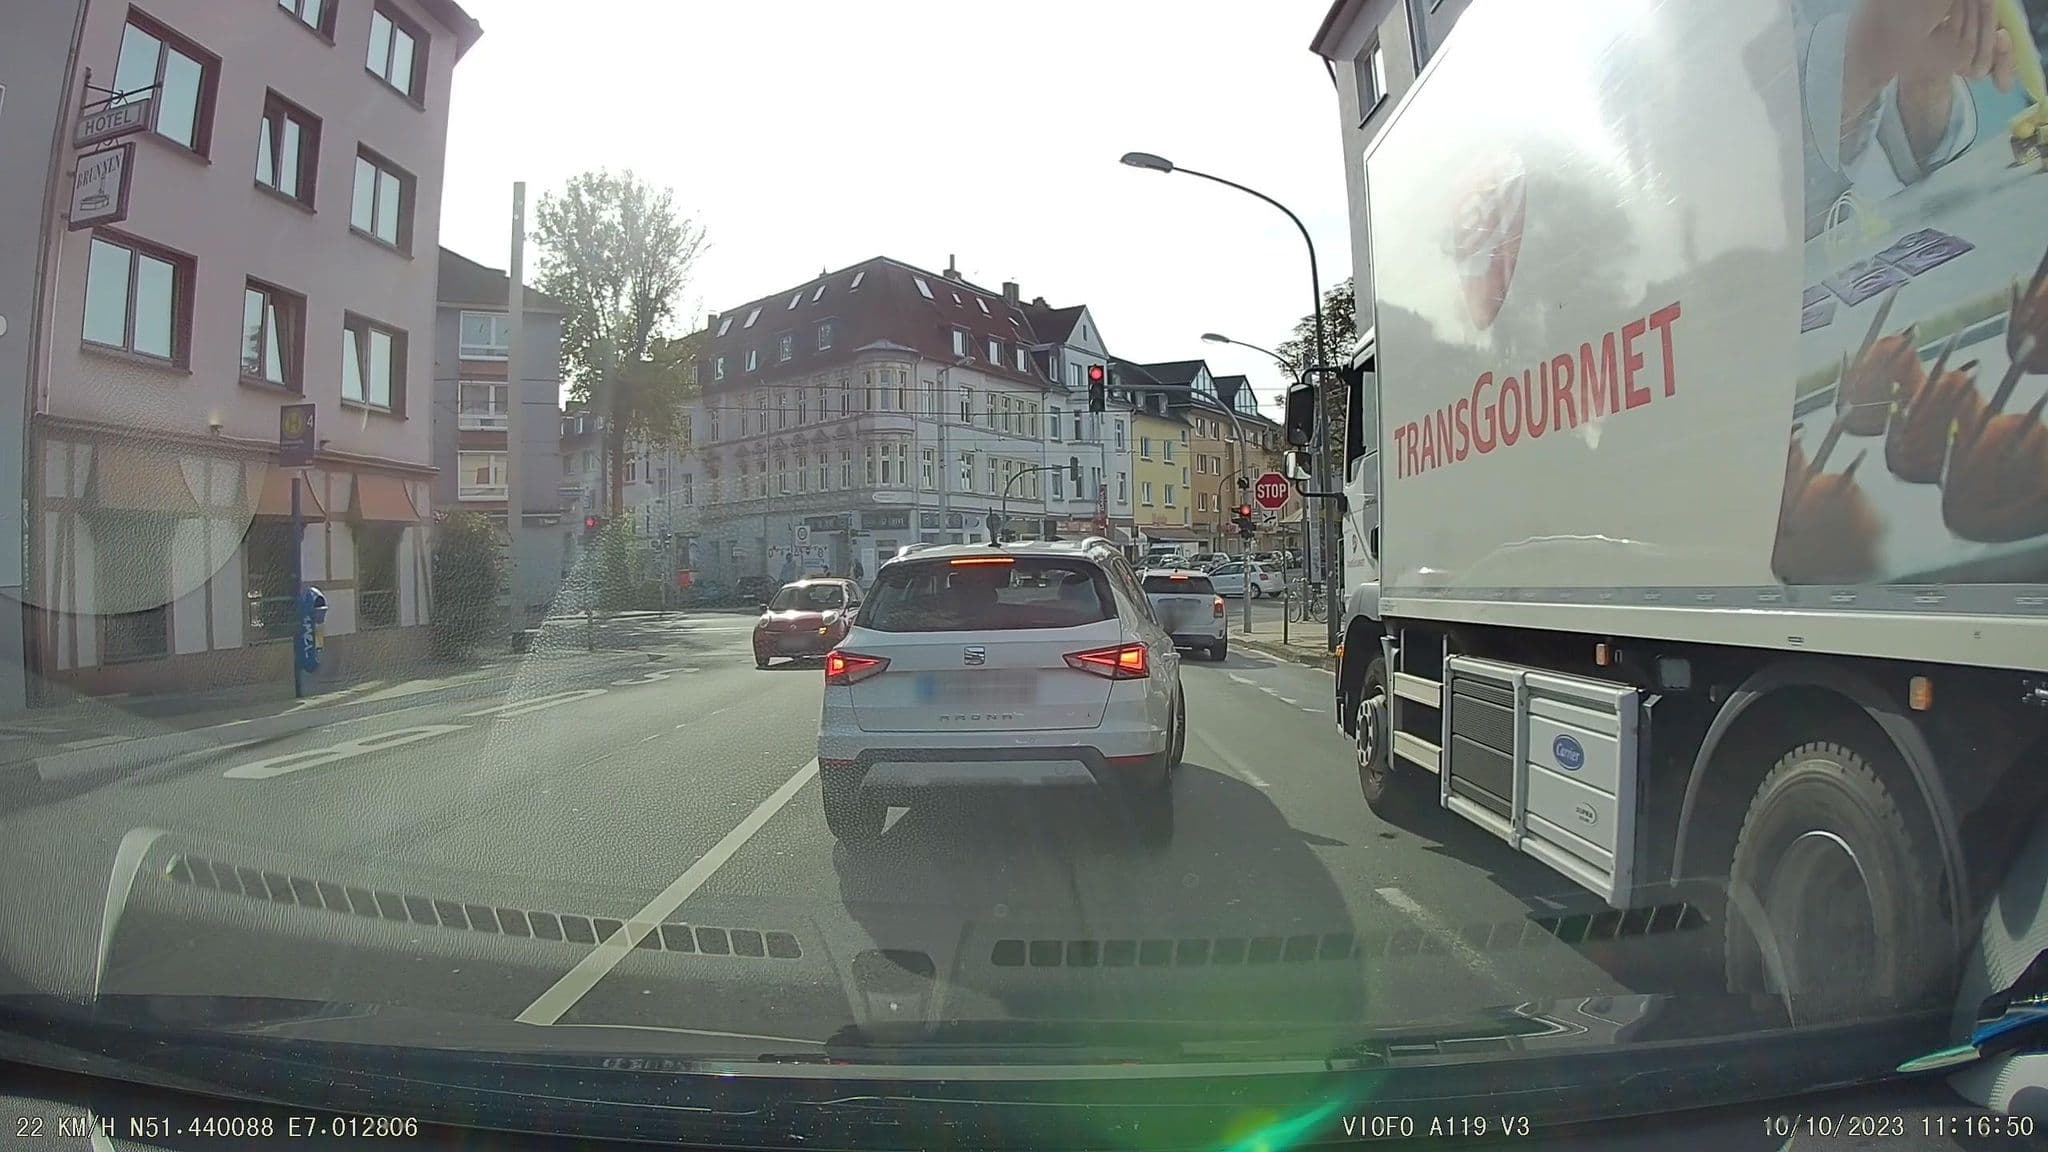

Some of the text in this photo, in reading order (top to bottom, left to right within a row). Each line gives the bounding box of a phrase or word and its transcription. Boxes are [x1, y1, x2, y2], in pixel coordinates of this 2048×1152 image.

[85, 109, 132, 135] HOTEL
[1394, 300, 1682, 480] TRANSGOURMET
[1257, 484, 1287, 503] STOP
